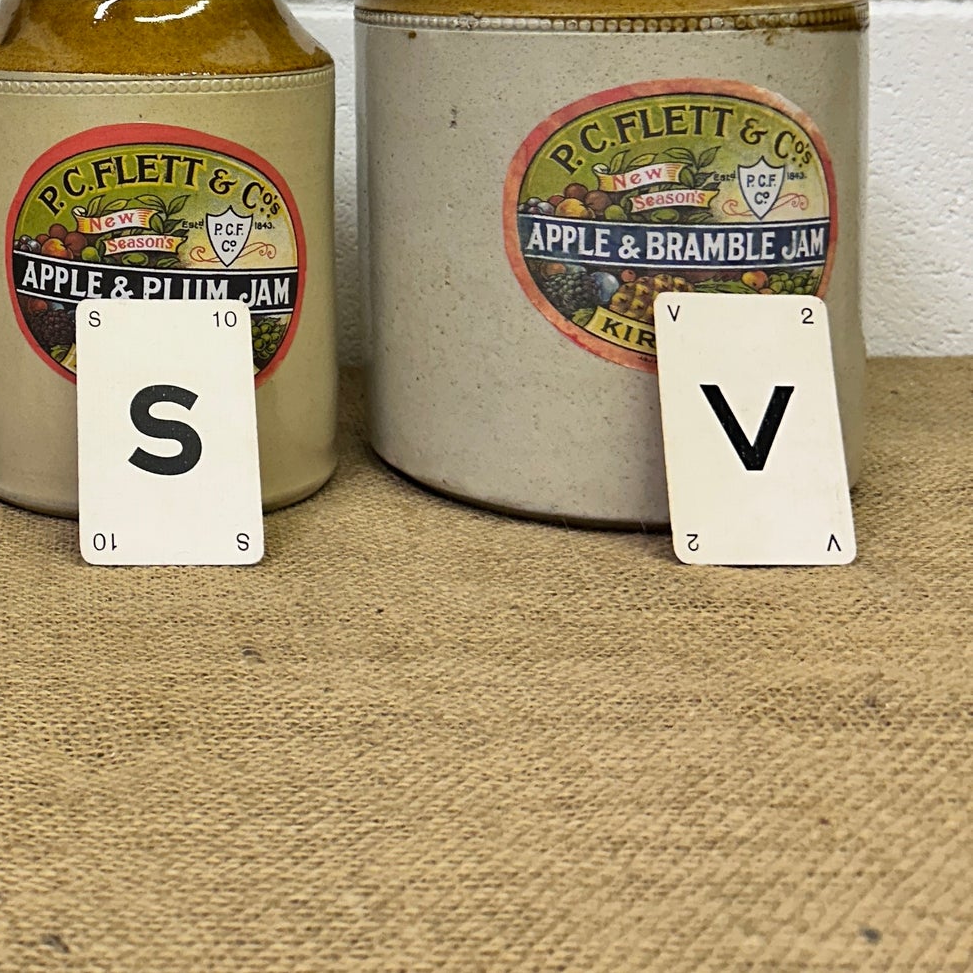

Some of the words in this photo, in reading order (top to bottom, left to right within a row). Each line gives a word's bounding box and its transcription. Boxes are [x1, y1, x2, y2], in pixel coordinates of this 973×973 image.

[740, 118, 768, 145] &
[209, 169, 237, 195] &
[633, 191, 706, 211] Season's
[108, 237, 174, 253] Season's
[526, 222, 610, 258] APPLE
[618, 235, 640, 259] &
[646, 231, 776, 261] BRAMBLE
[782, 227, 825, 260] JAM
[22, 261, 103, 299] APPLE
[110, 276, 134, 299] &
[239, 278, 290, 307] JAM
[88, 310, 101, 328] S
[212, 310, 237, 328] 10
[667, 304, 681, 322] V
[801, 307, 815, 324] 2
[128, 384, 202, 476] S
[699, 384, 795, 471] V
